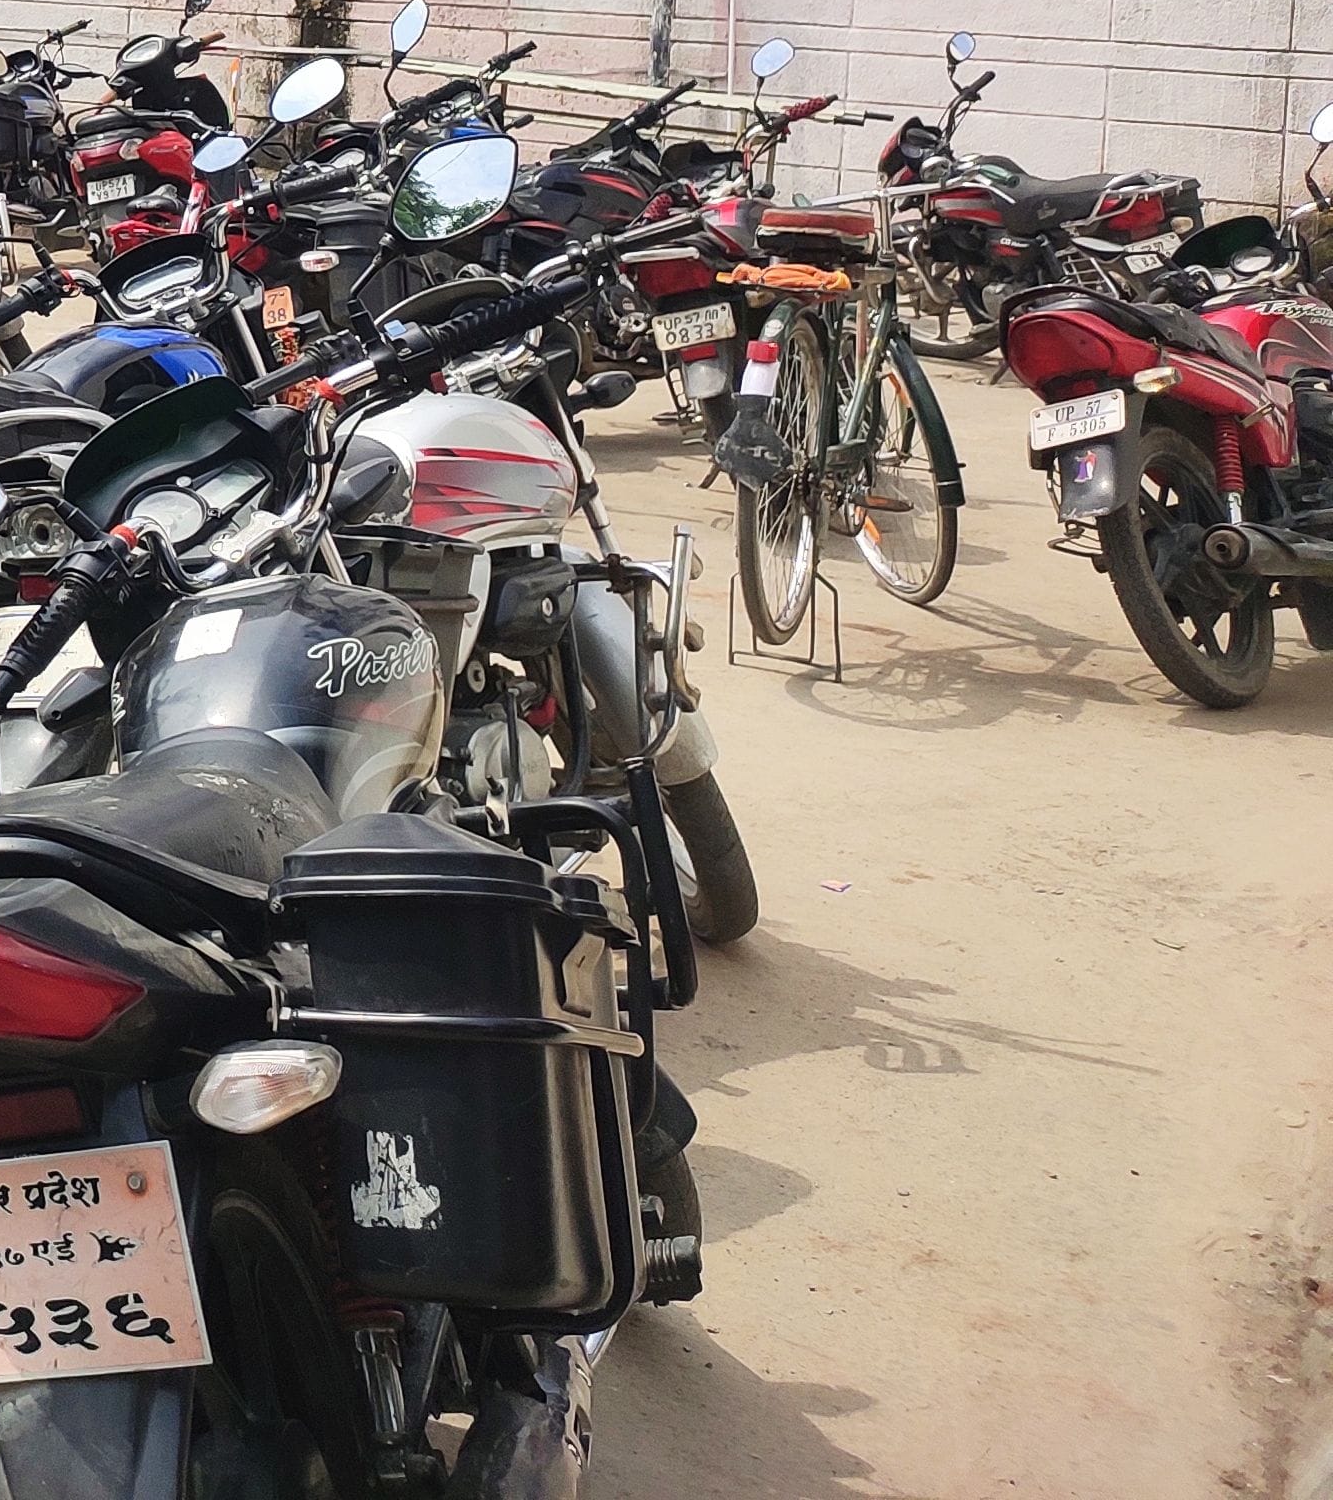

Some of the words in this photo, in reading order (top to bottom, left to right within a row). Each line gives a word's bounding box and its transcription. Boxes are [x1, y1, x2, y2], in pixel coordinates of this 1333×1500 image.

[665, 322, 714, 345] 0833
[1055, 405, 1075, 423] UP
[1085, 399, 1101, 415] 57
[1069, 415, 1107, 438] 5305
[21, 1170, 101, 1210] प्रदेश
